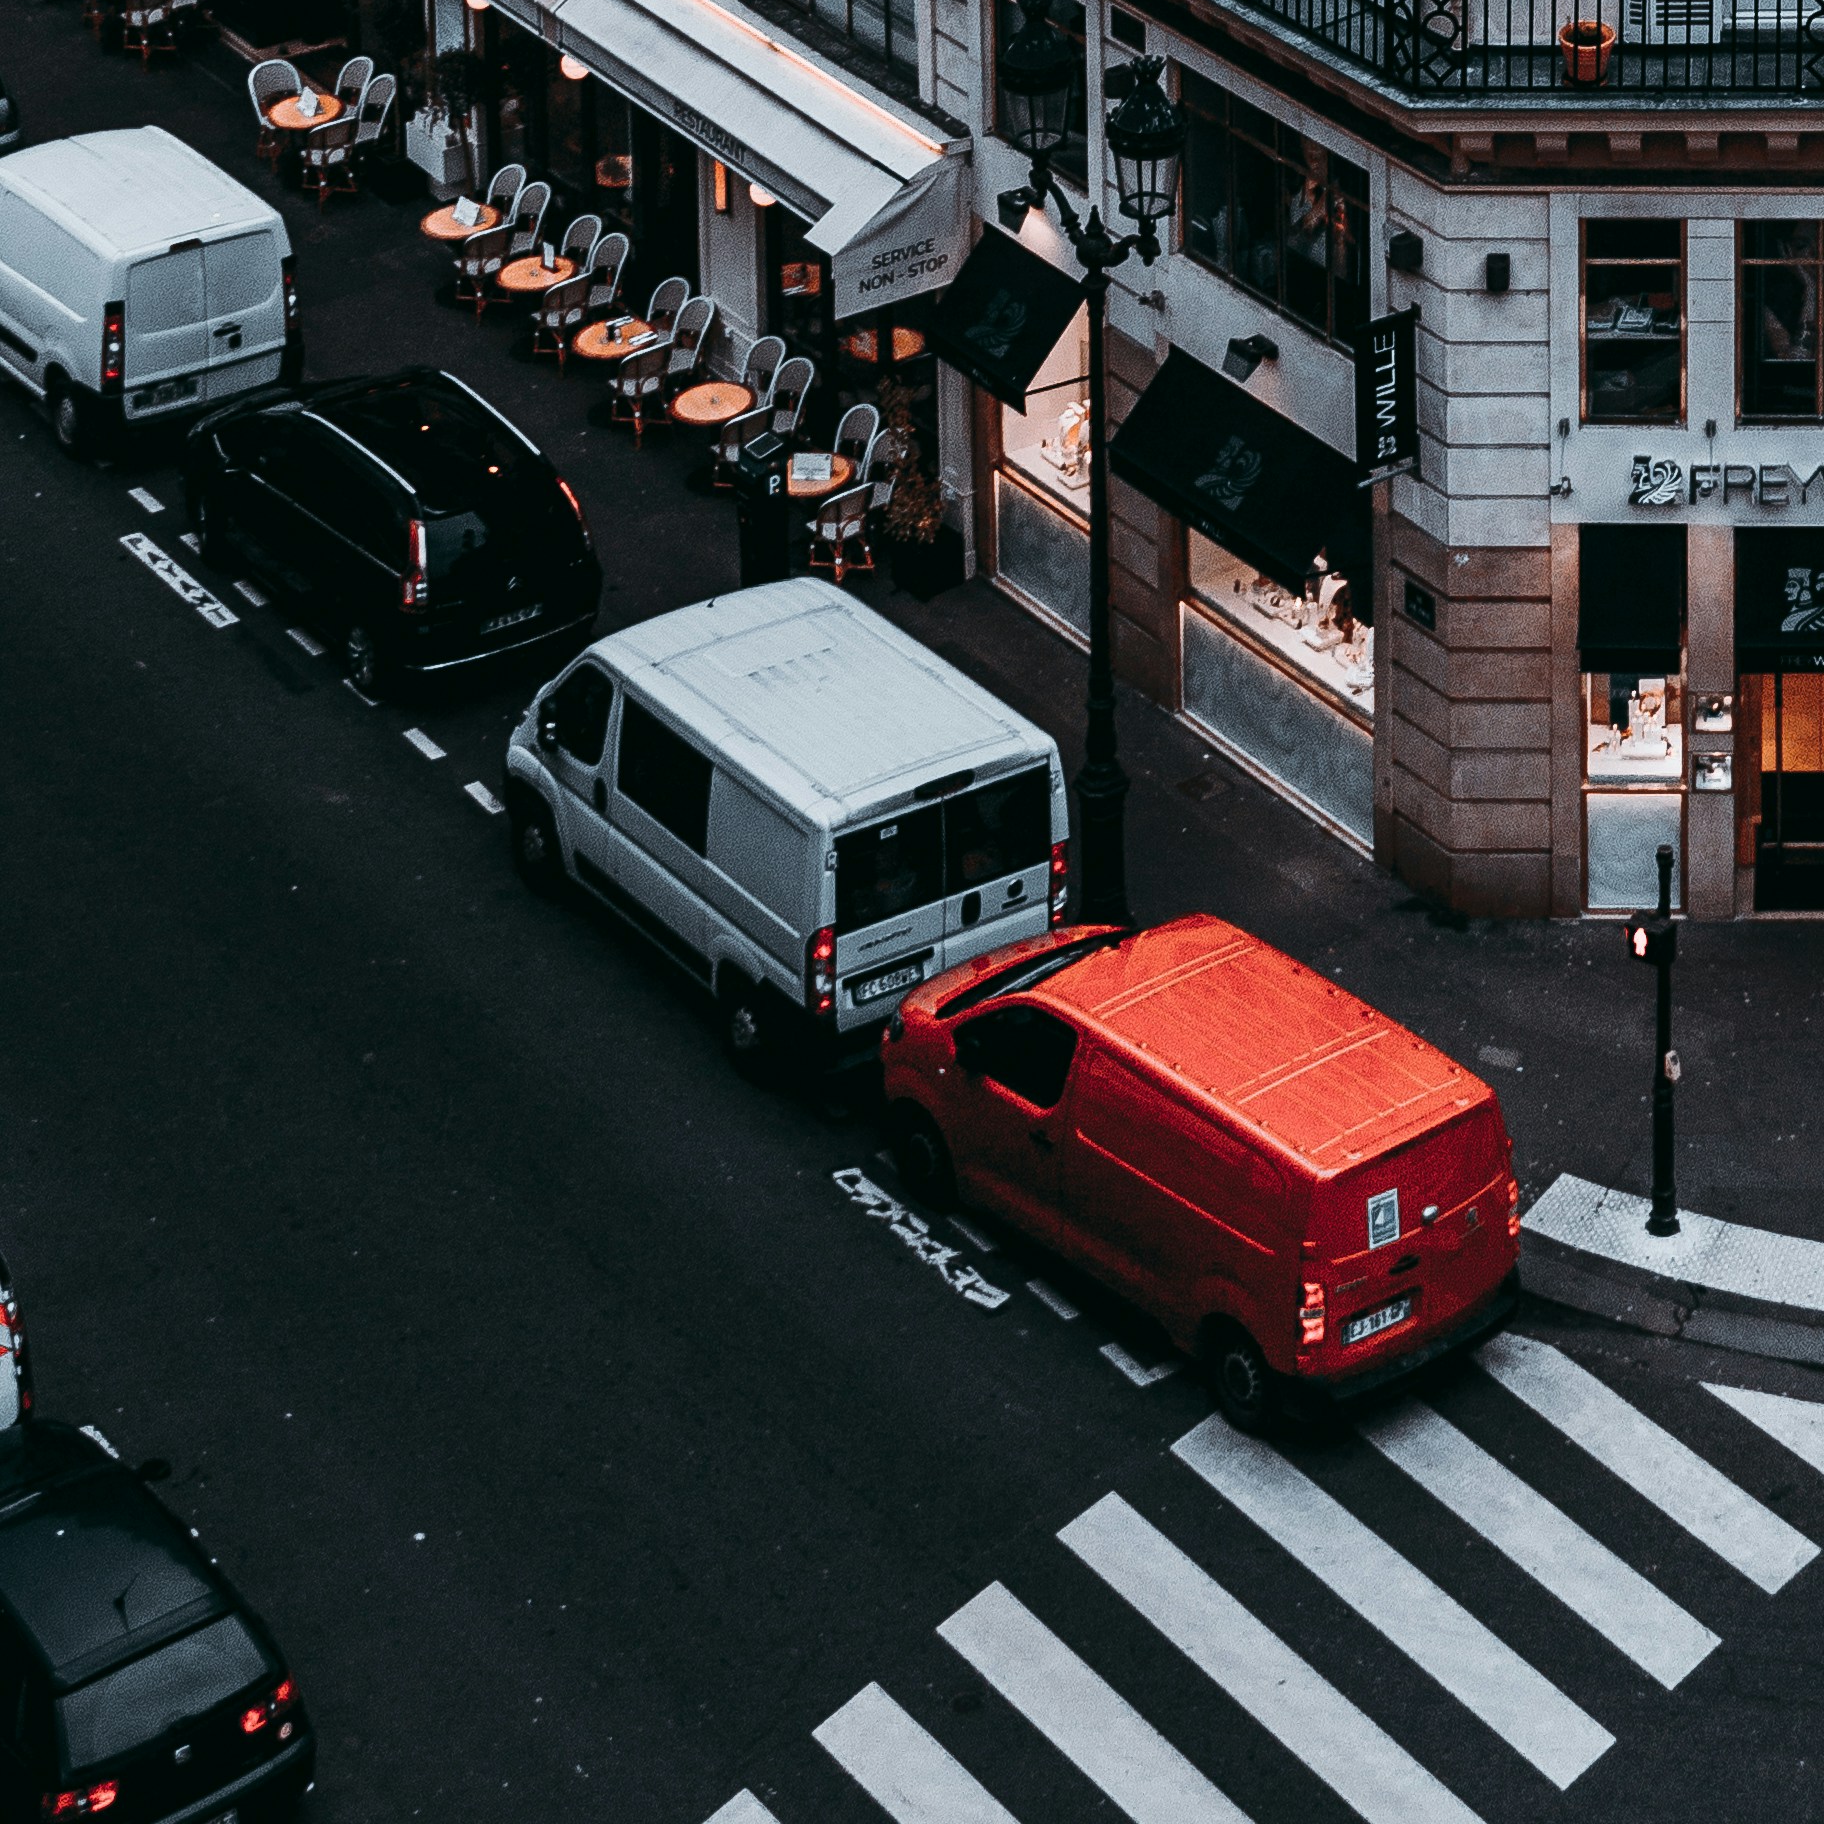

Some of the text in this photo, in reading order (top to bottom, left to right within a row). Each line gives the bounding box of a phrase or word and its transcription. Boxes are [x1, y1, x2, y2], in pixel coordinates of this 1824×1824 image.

[859, 270, 895, 294] NON
[907, 253, 949, 279] STOP
[871, 237, 936, 271] SERVICE
[1373, 330, 1397, 429] WILLE
